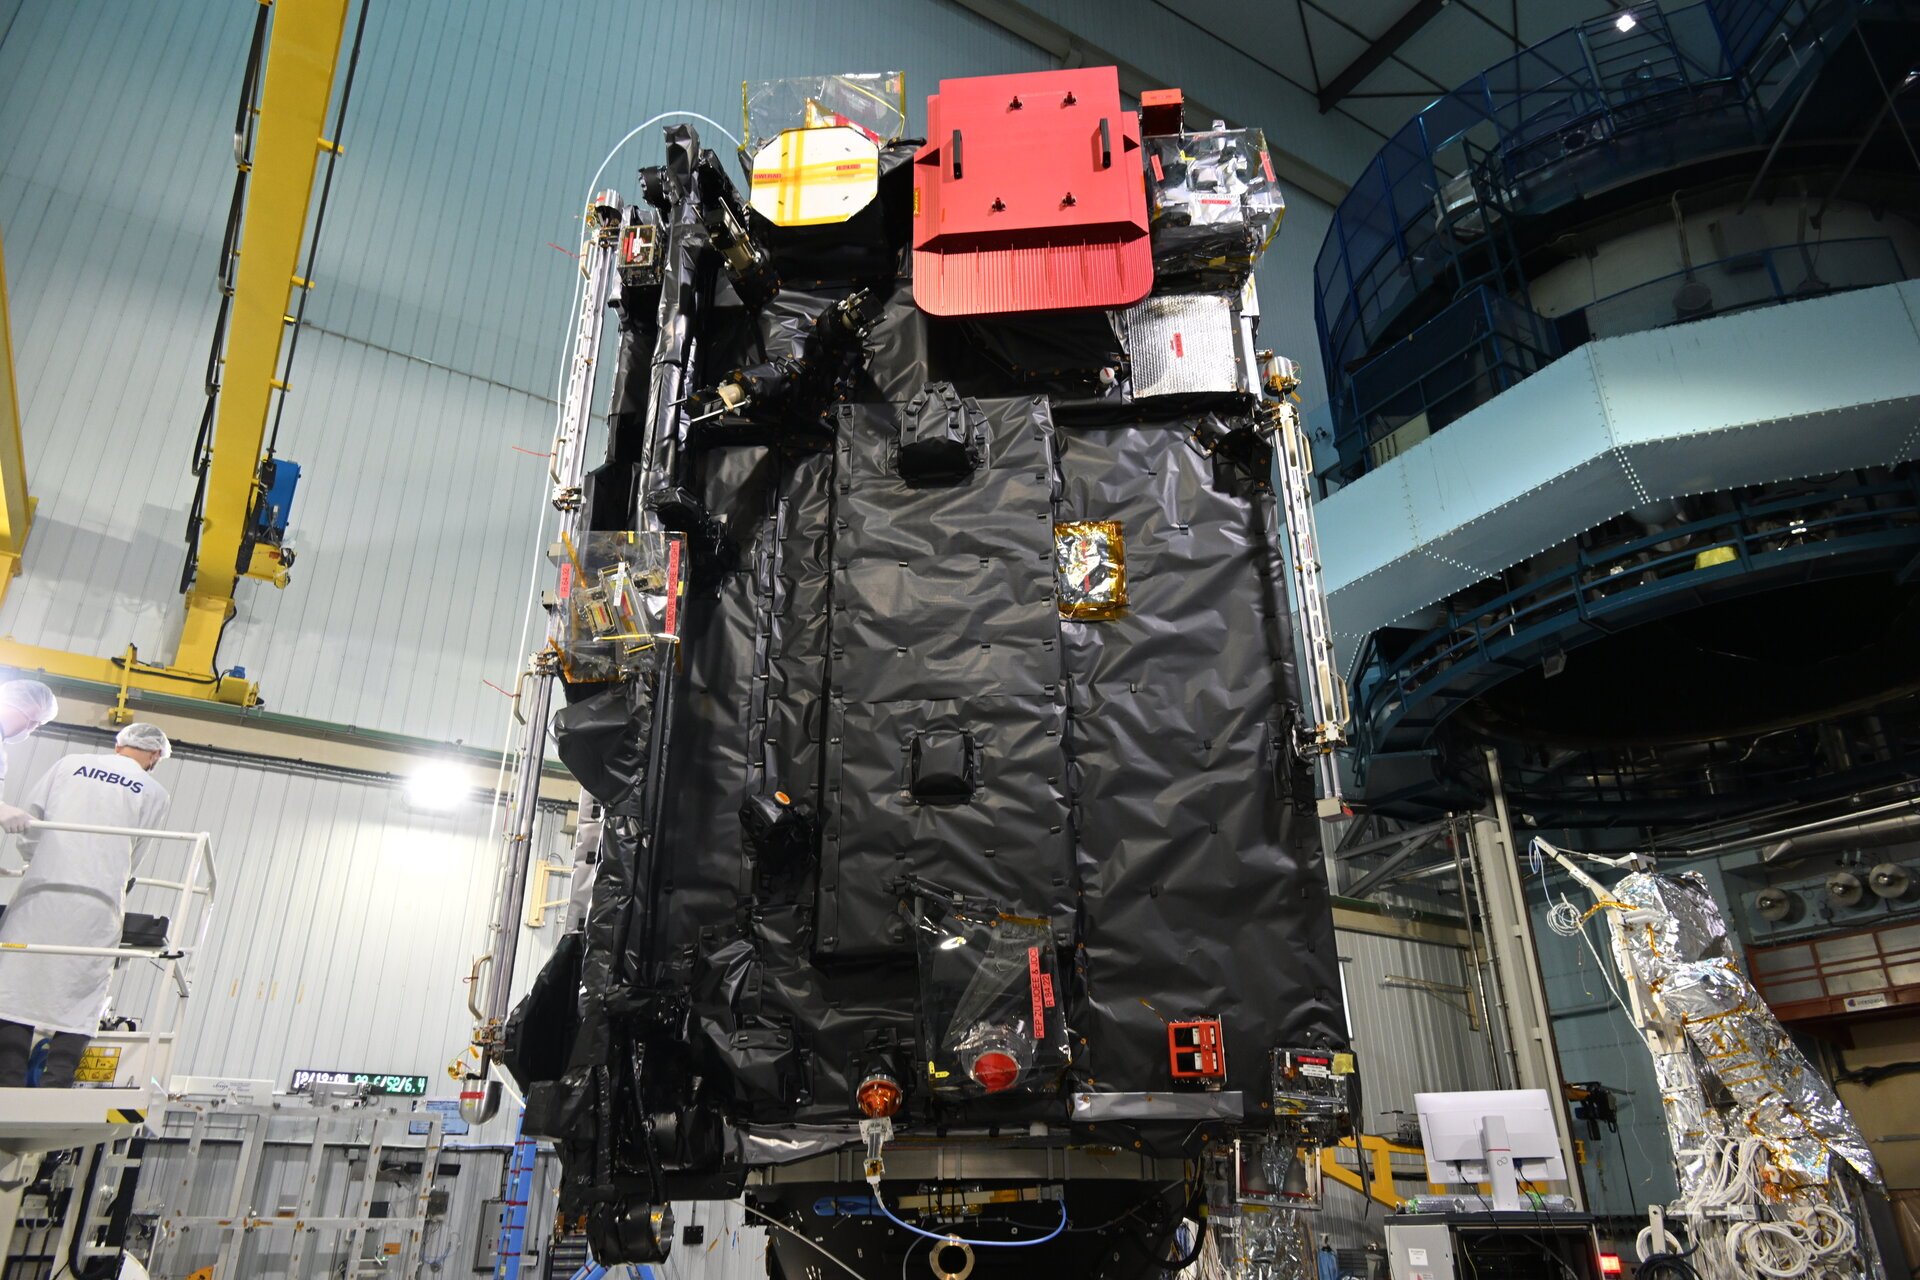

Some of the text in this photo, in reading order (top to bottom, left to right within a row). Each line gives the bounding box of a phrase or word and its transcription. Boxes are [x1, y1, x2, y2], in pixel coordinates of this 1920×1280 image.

[668, 571, 677, 597] BEFORE
[666, 600, 675, 632] REMOVE
[73, 766, 144, 793] AIRBUS
[1034, 1005, 1042, 1017] ZU
[1035, 1020, 1043, 1038] PEP
